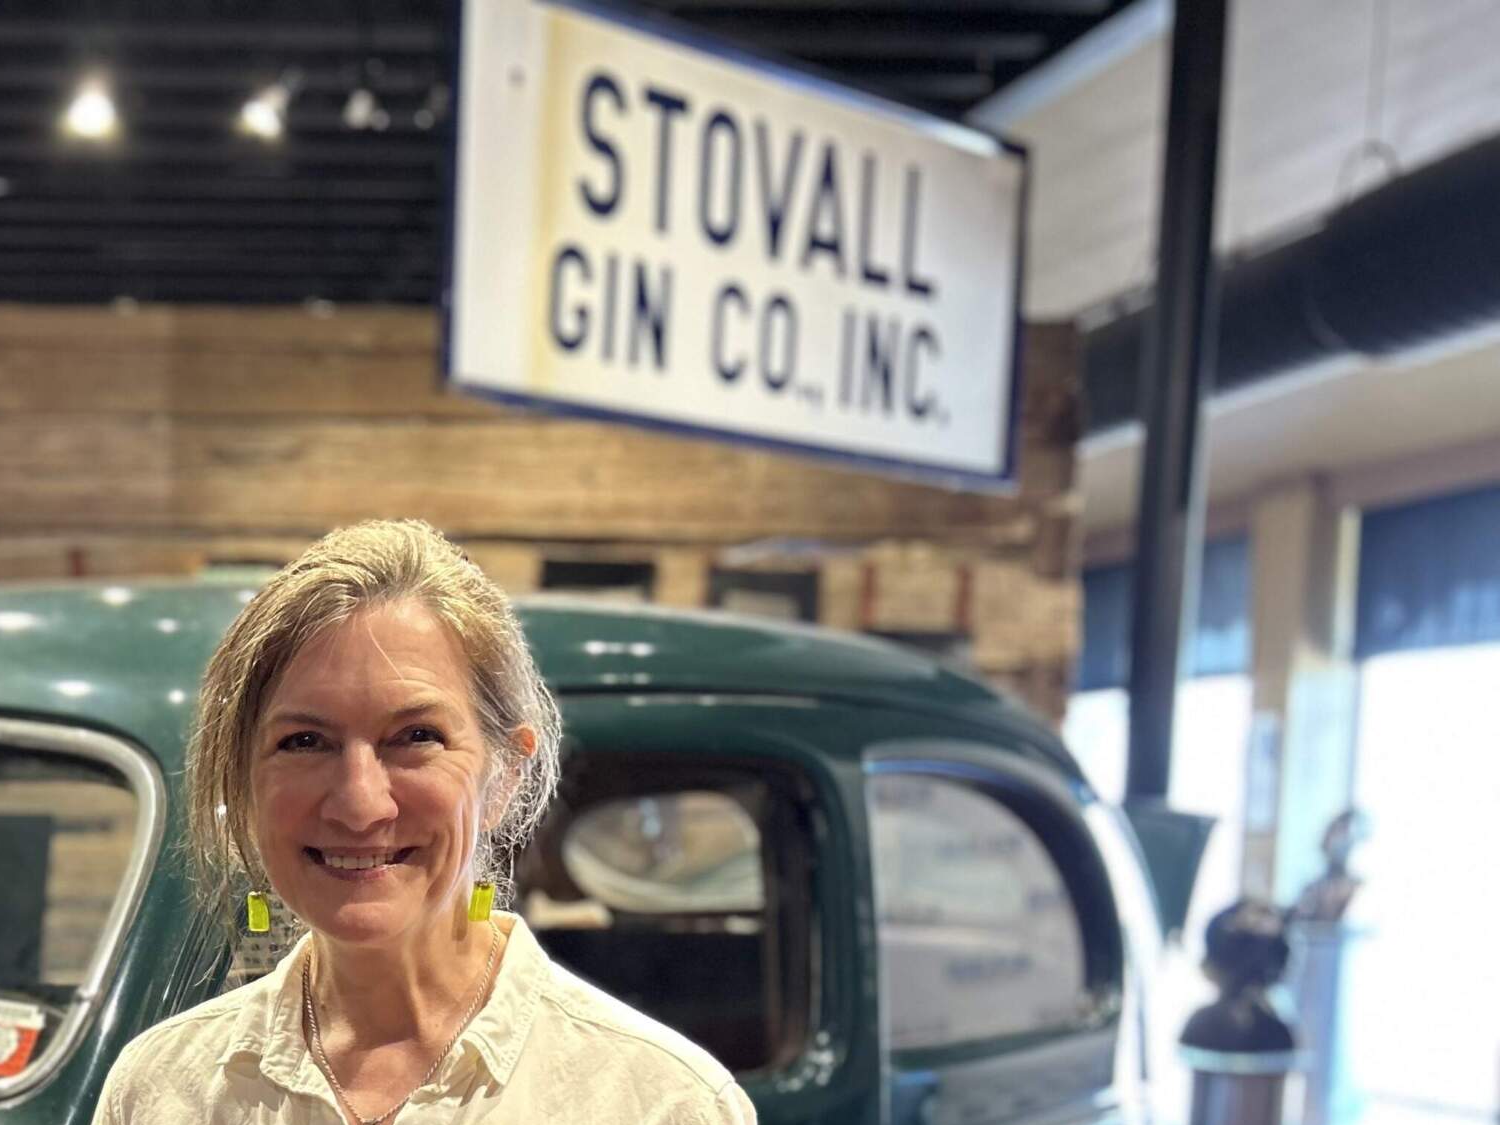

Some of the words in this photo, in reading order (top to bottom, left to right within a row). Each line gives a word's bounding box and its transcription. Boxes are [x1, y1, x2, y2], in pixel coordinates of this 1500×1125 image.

[576, 71, 935, 298] STOVALL
[546, 245, 673, 374] GIN
[837, 304, 950, 426] INC.
